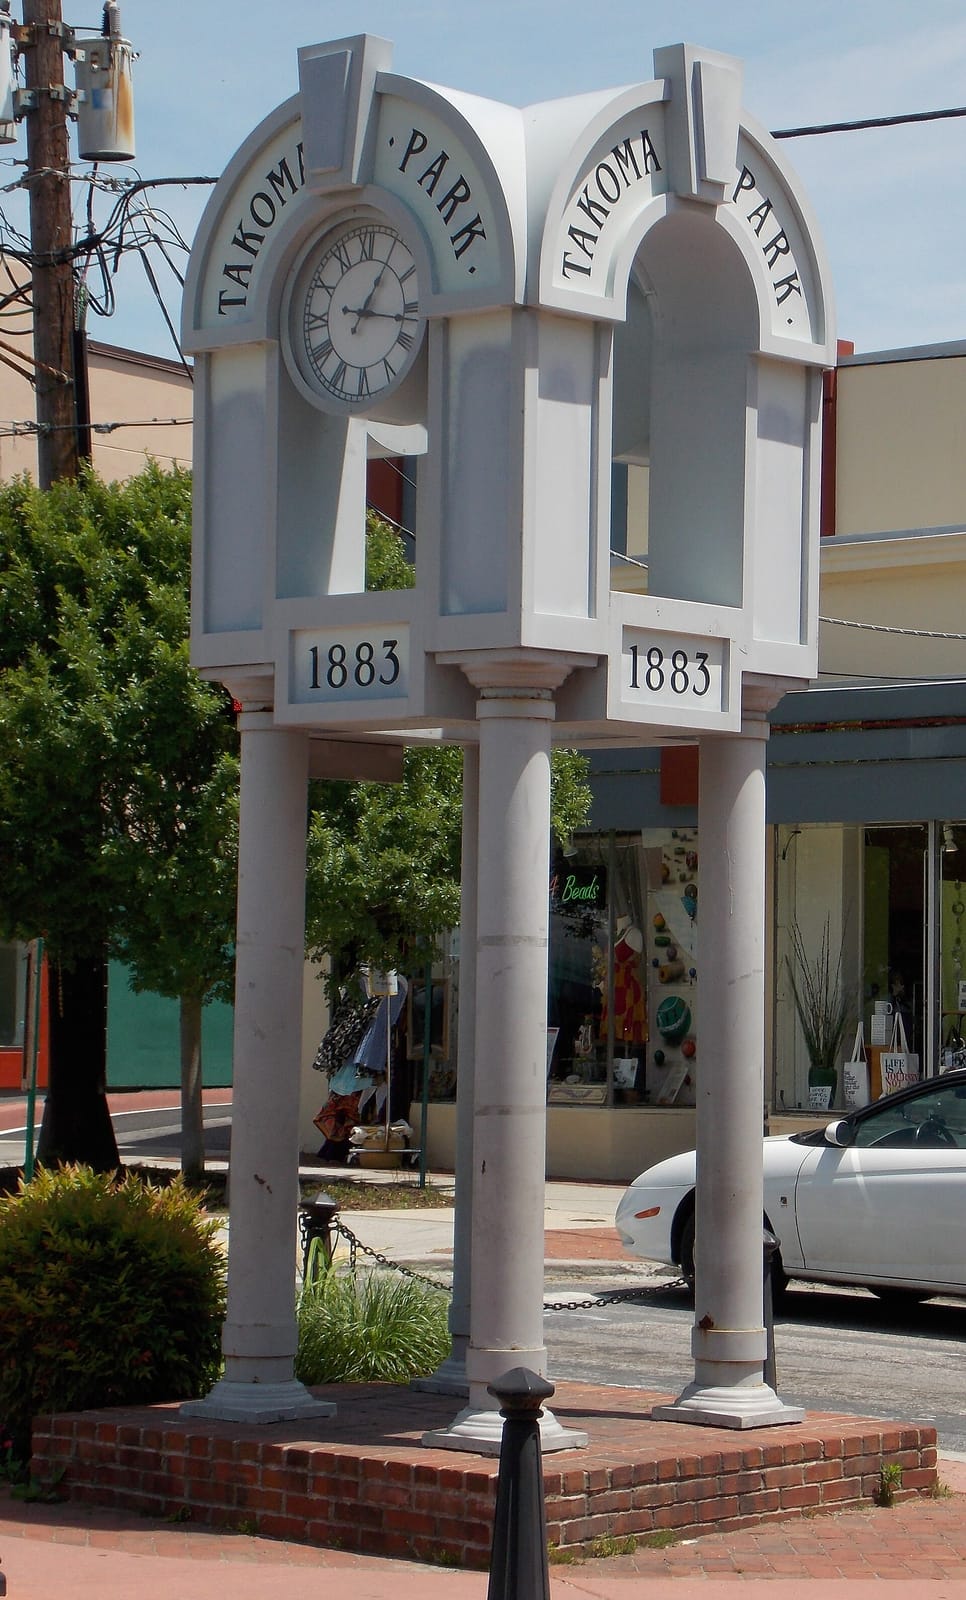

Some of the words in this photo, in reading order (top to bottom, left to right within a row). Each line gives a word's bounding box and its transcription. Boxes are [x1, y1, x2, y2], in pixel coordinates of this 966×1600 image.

[397, 128, 487, 261] PARK
[561, 129, 662, 280] TAKOMA
[732, 164, 802, 306] PARK
[308, 639, 401, 690] 1883
[628, 644, 711, 697] 1883
[561, 873, 600, 902] Beads
[885, 1059, 905, 1069] LIFE
